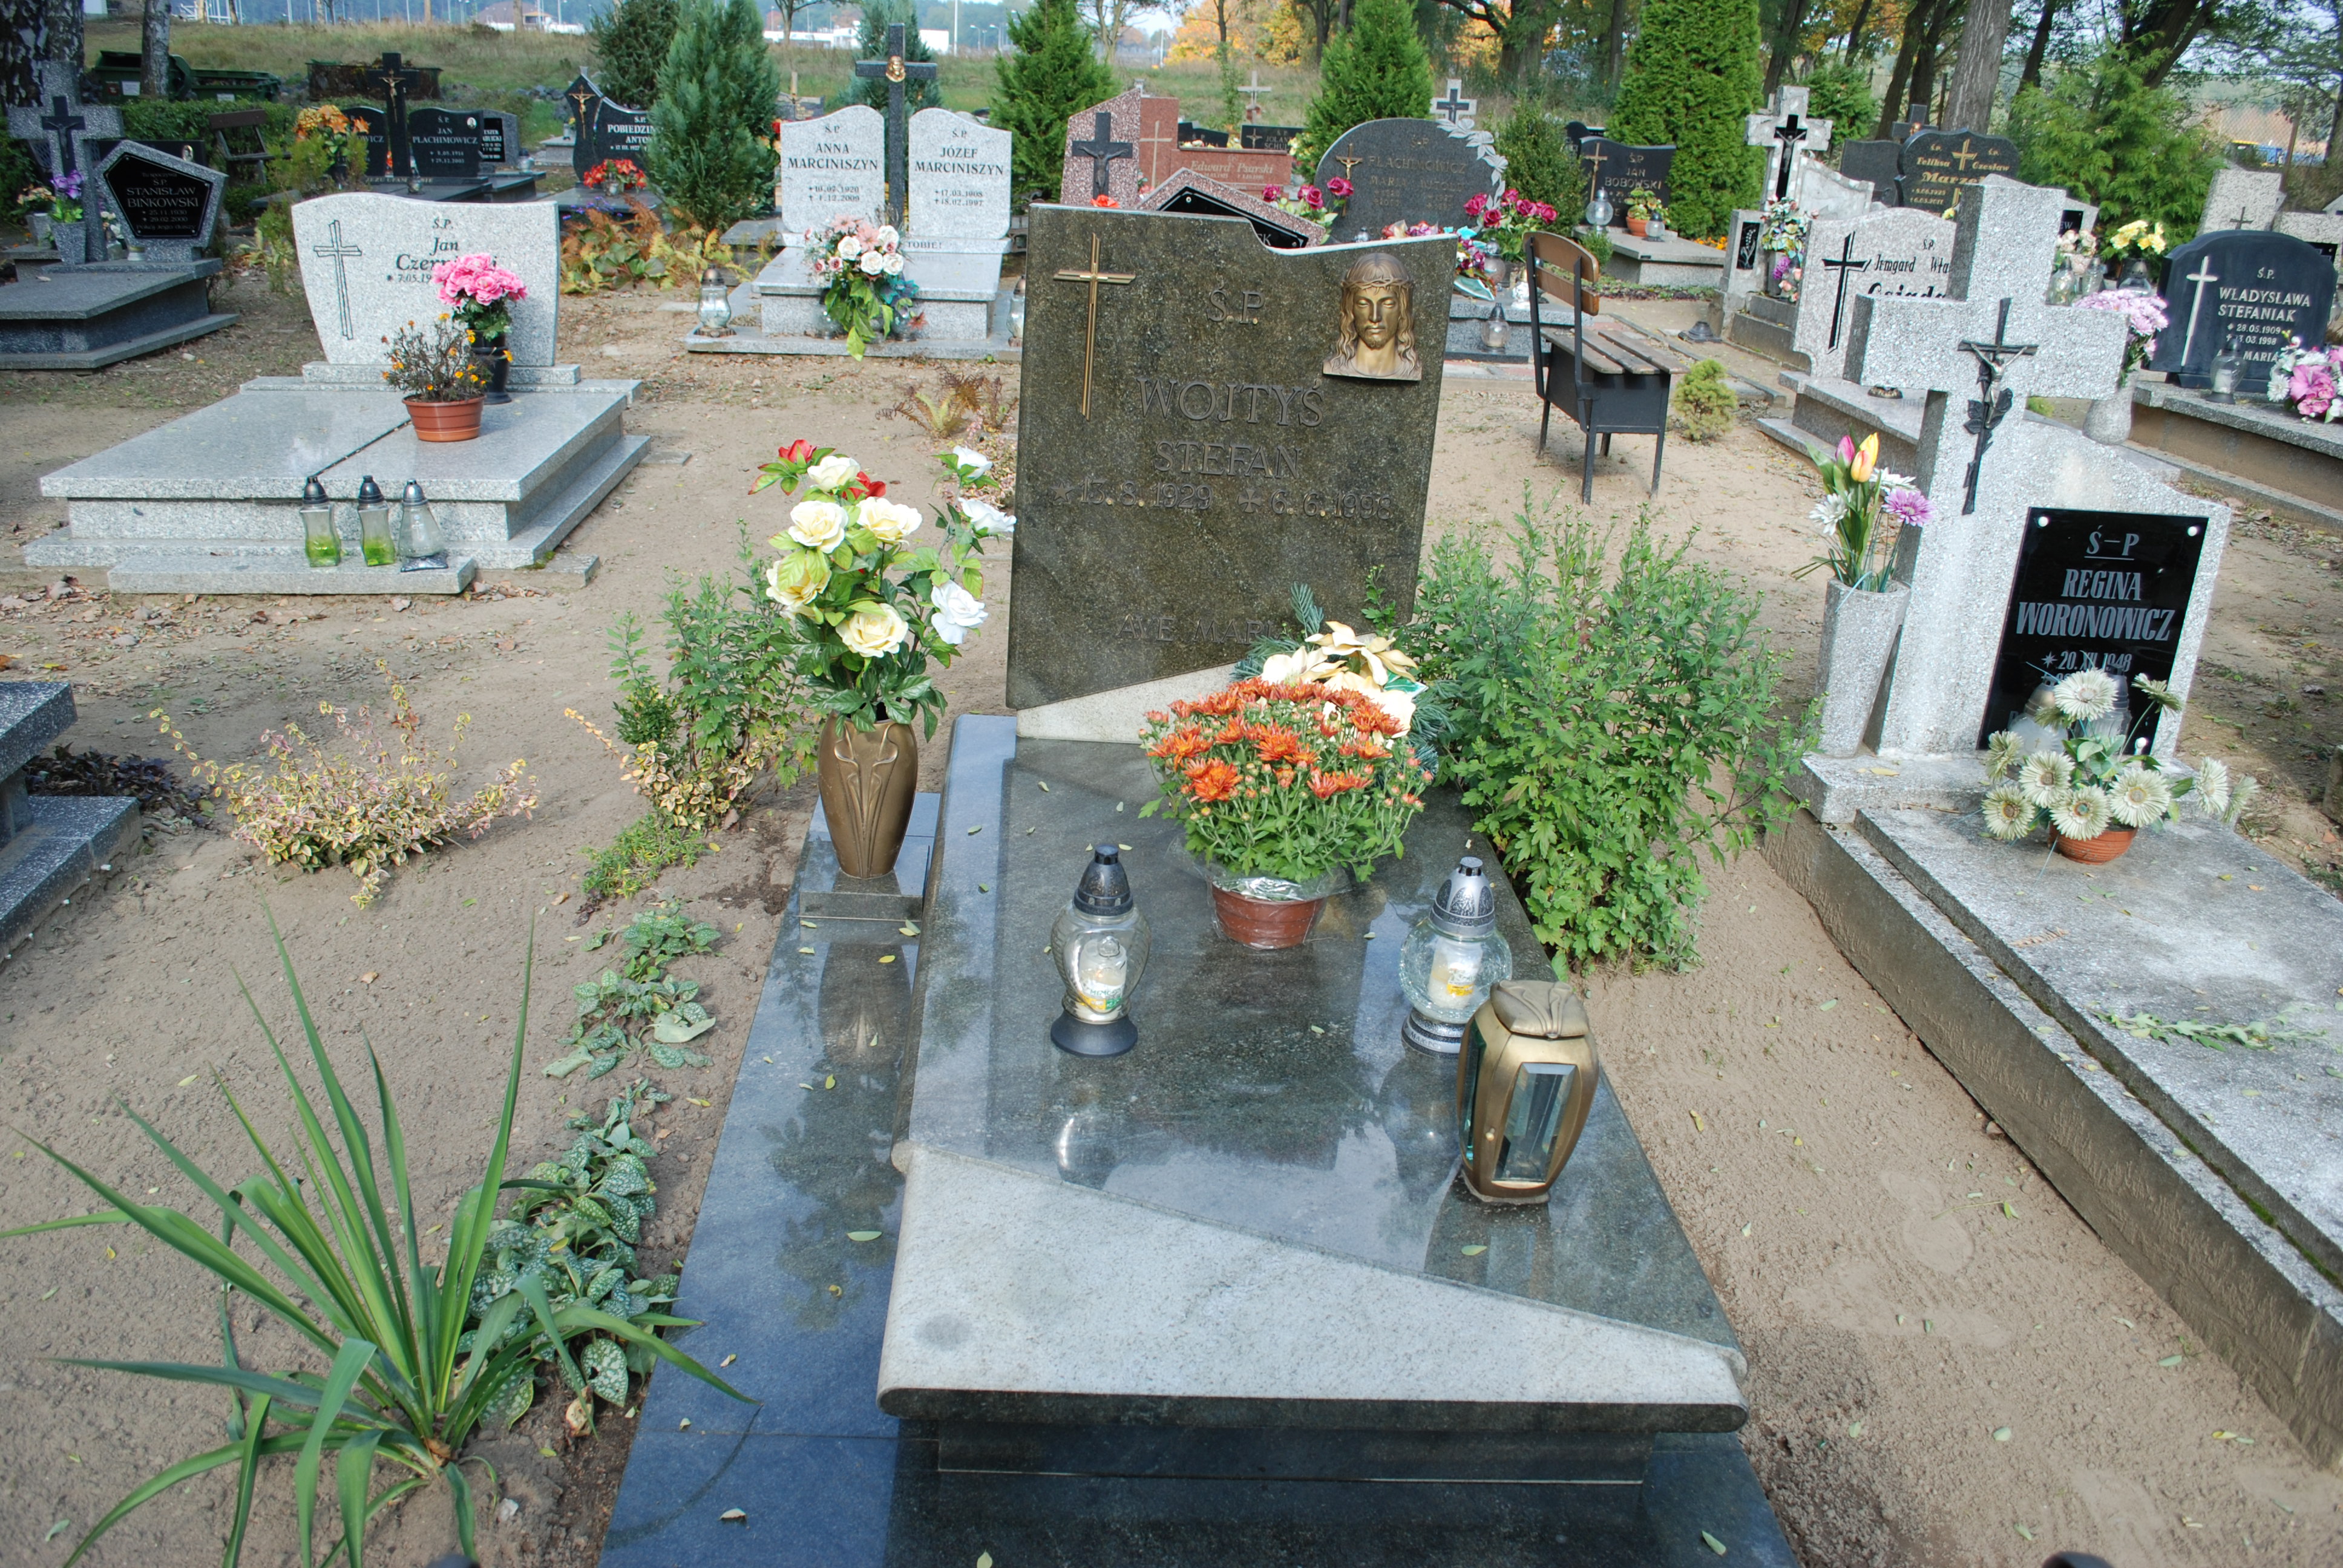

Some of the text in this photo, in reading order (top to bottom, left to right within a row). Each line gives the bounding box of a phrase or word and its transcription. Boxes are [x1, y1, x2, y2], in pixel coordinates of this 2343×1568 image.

[816, 143, 850, 154] ANNA
[940, 145, 977, 158] JÓZEF
[788, 157, 877, 170] MARCINISZYN
[914, 162, 1003, 175] MARCINISZYN
[1190, 161, 1274, 174] Edward Psarski
[1972, 162, 2010, 171] Czesław
[1626, 168, 1646, 177] JAN
[1605, 177, 1662, 189] BOBOWSKI
[126, 188, 196, 196] STANISŁAW
[429, 237, 459, 256] Jan
[398, 273, 432, 283] 7.05.19
[2219, 287, 2310, 307] WŁADYSŁAWA
[2218, 304, 2296, 322] STEFANIAK
[2236, 323, 2281, 335] 28.05.1909
[1135, 377, 1324, 427] WOJTYŚ
[1153, 440, 1301, 479] STEFAN
[2061, 569, 2141, 601] REGINA
[2016, 602, 2176, 641] WORONOWICZ
